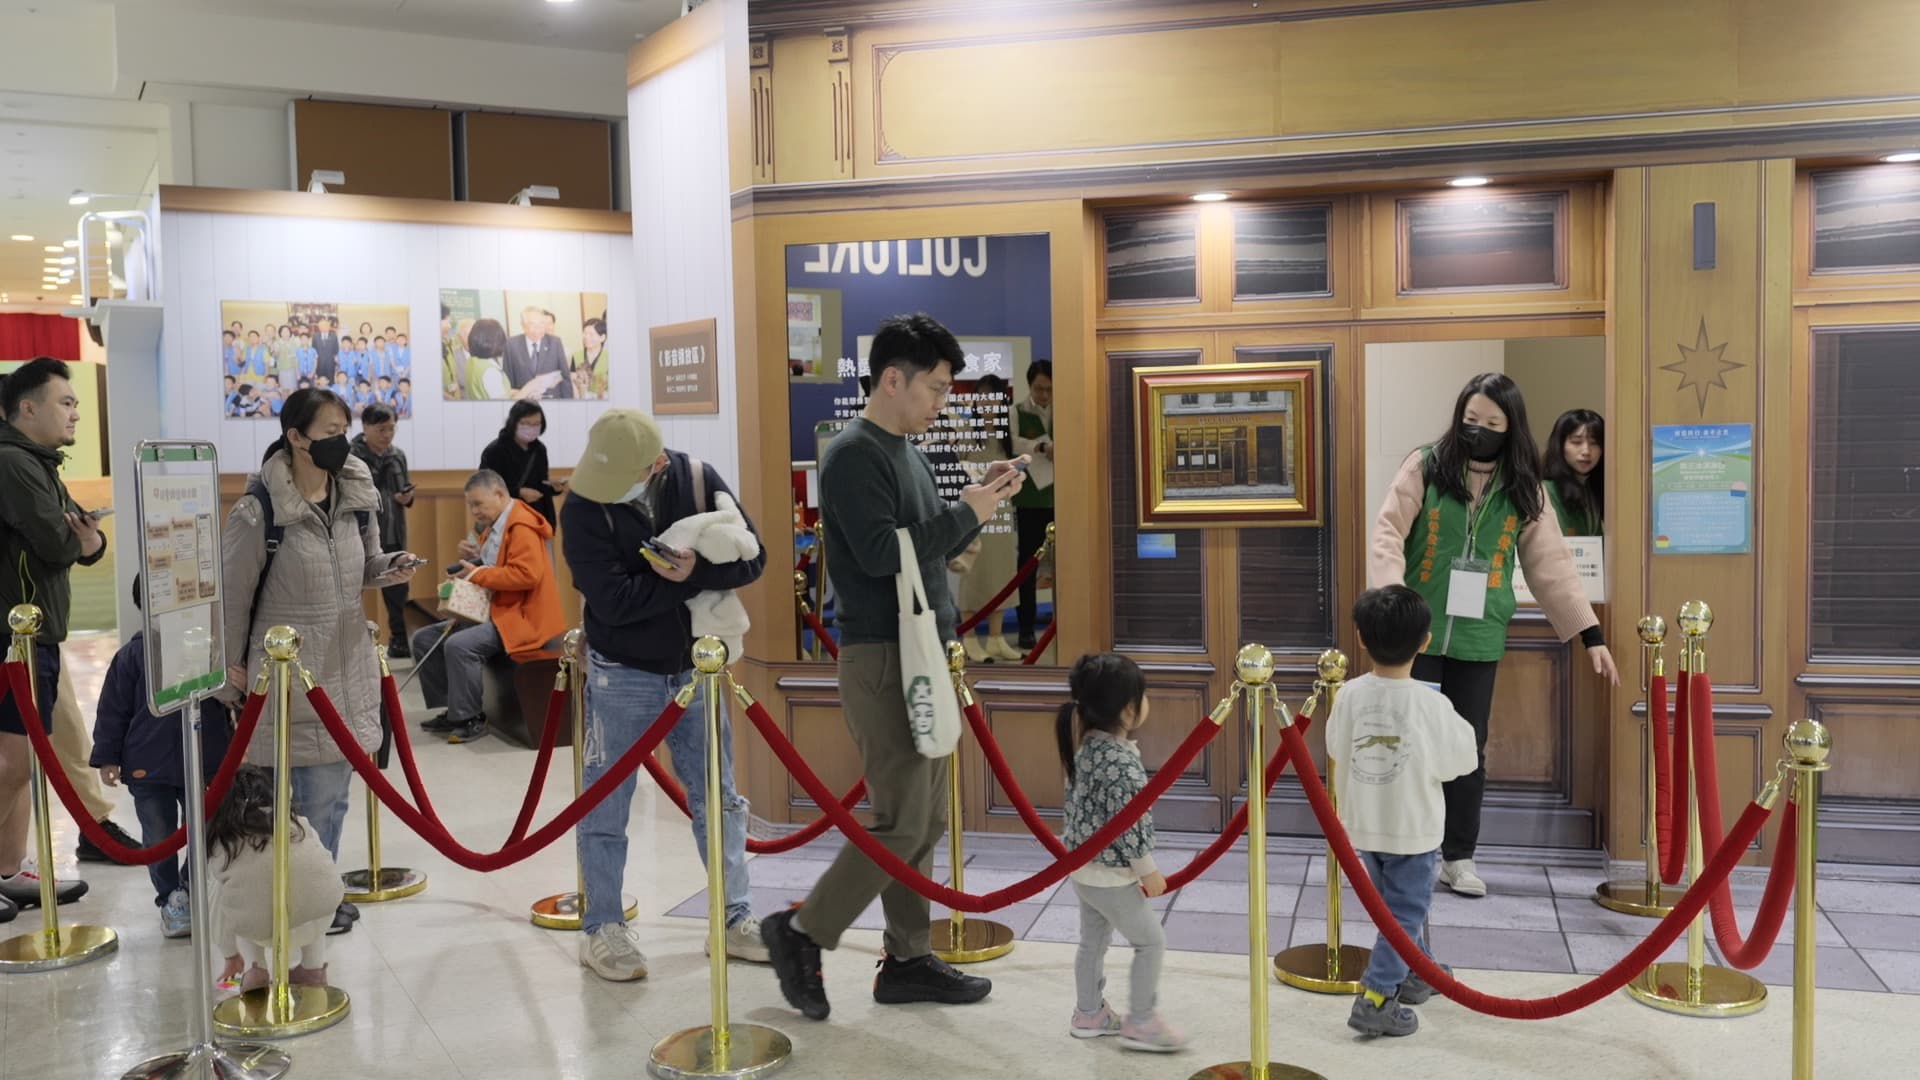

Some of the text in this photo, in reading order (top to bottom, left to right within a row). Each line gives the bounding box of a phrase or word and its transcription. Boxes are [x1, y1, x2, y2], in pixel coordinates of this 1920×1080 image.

[964, 352, 1002, 373] 食家
[946, 392, 1007, 402] 國企業的大老闆，
